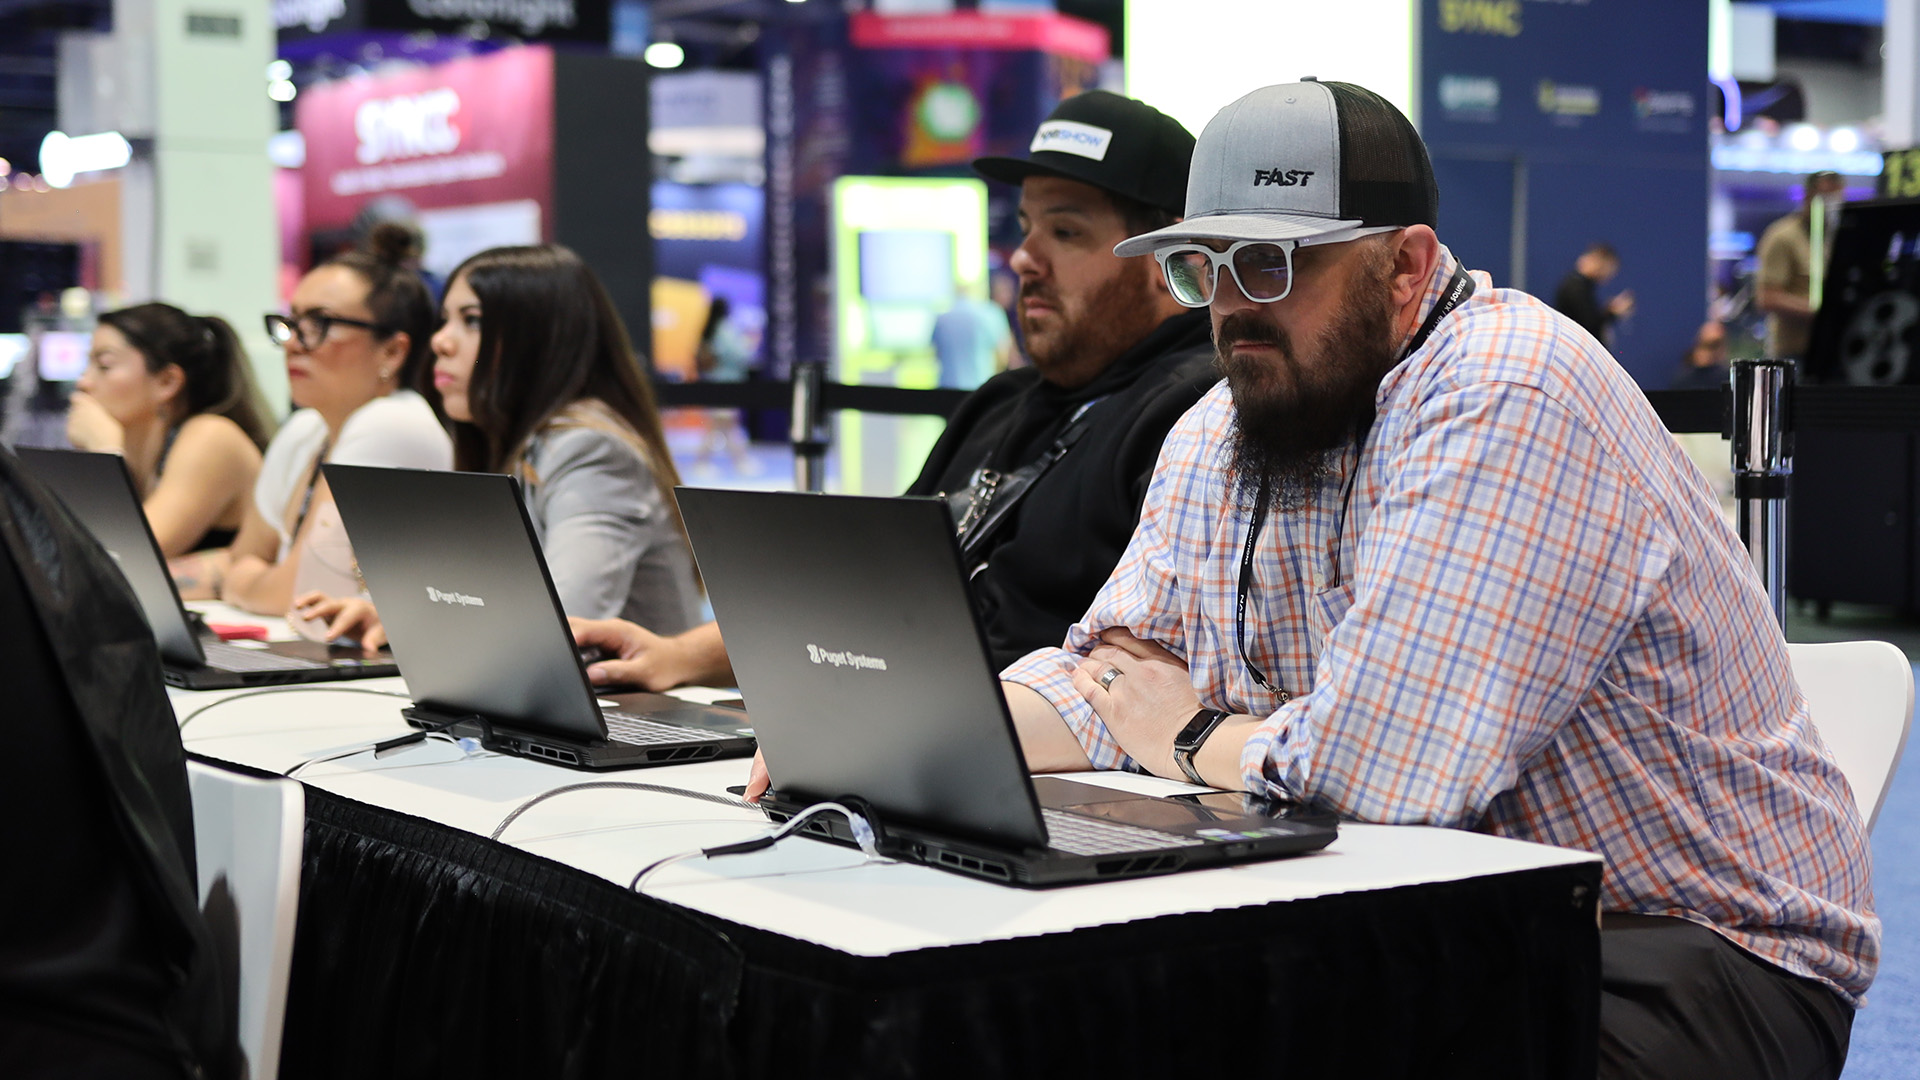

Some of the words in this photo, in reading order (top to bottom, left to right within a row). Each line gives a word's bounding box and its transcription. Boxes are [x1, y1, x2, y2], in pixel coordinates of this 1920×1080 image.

[1253, 167, 1315, 187] FAST
[1444, 301, 1454, 312] XR
[819, 647, 848, 668] Puget
[845, 651, 887, 671] Systems
